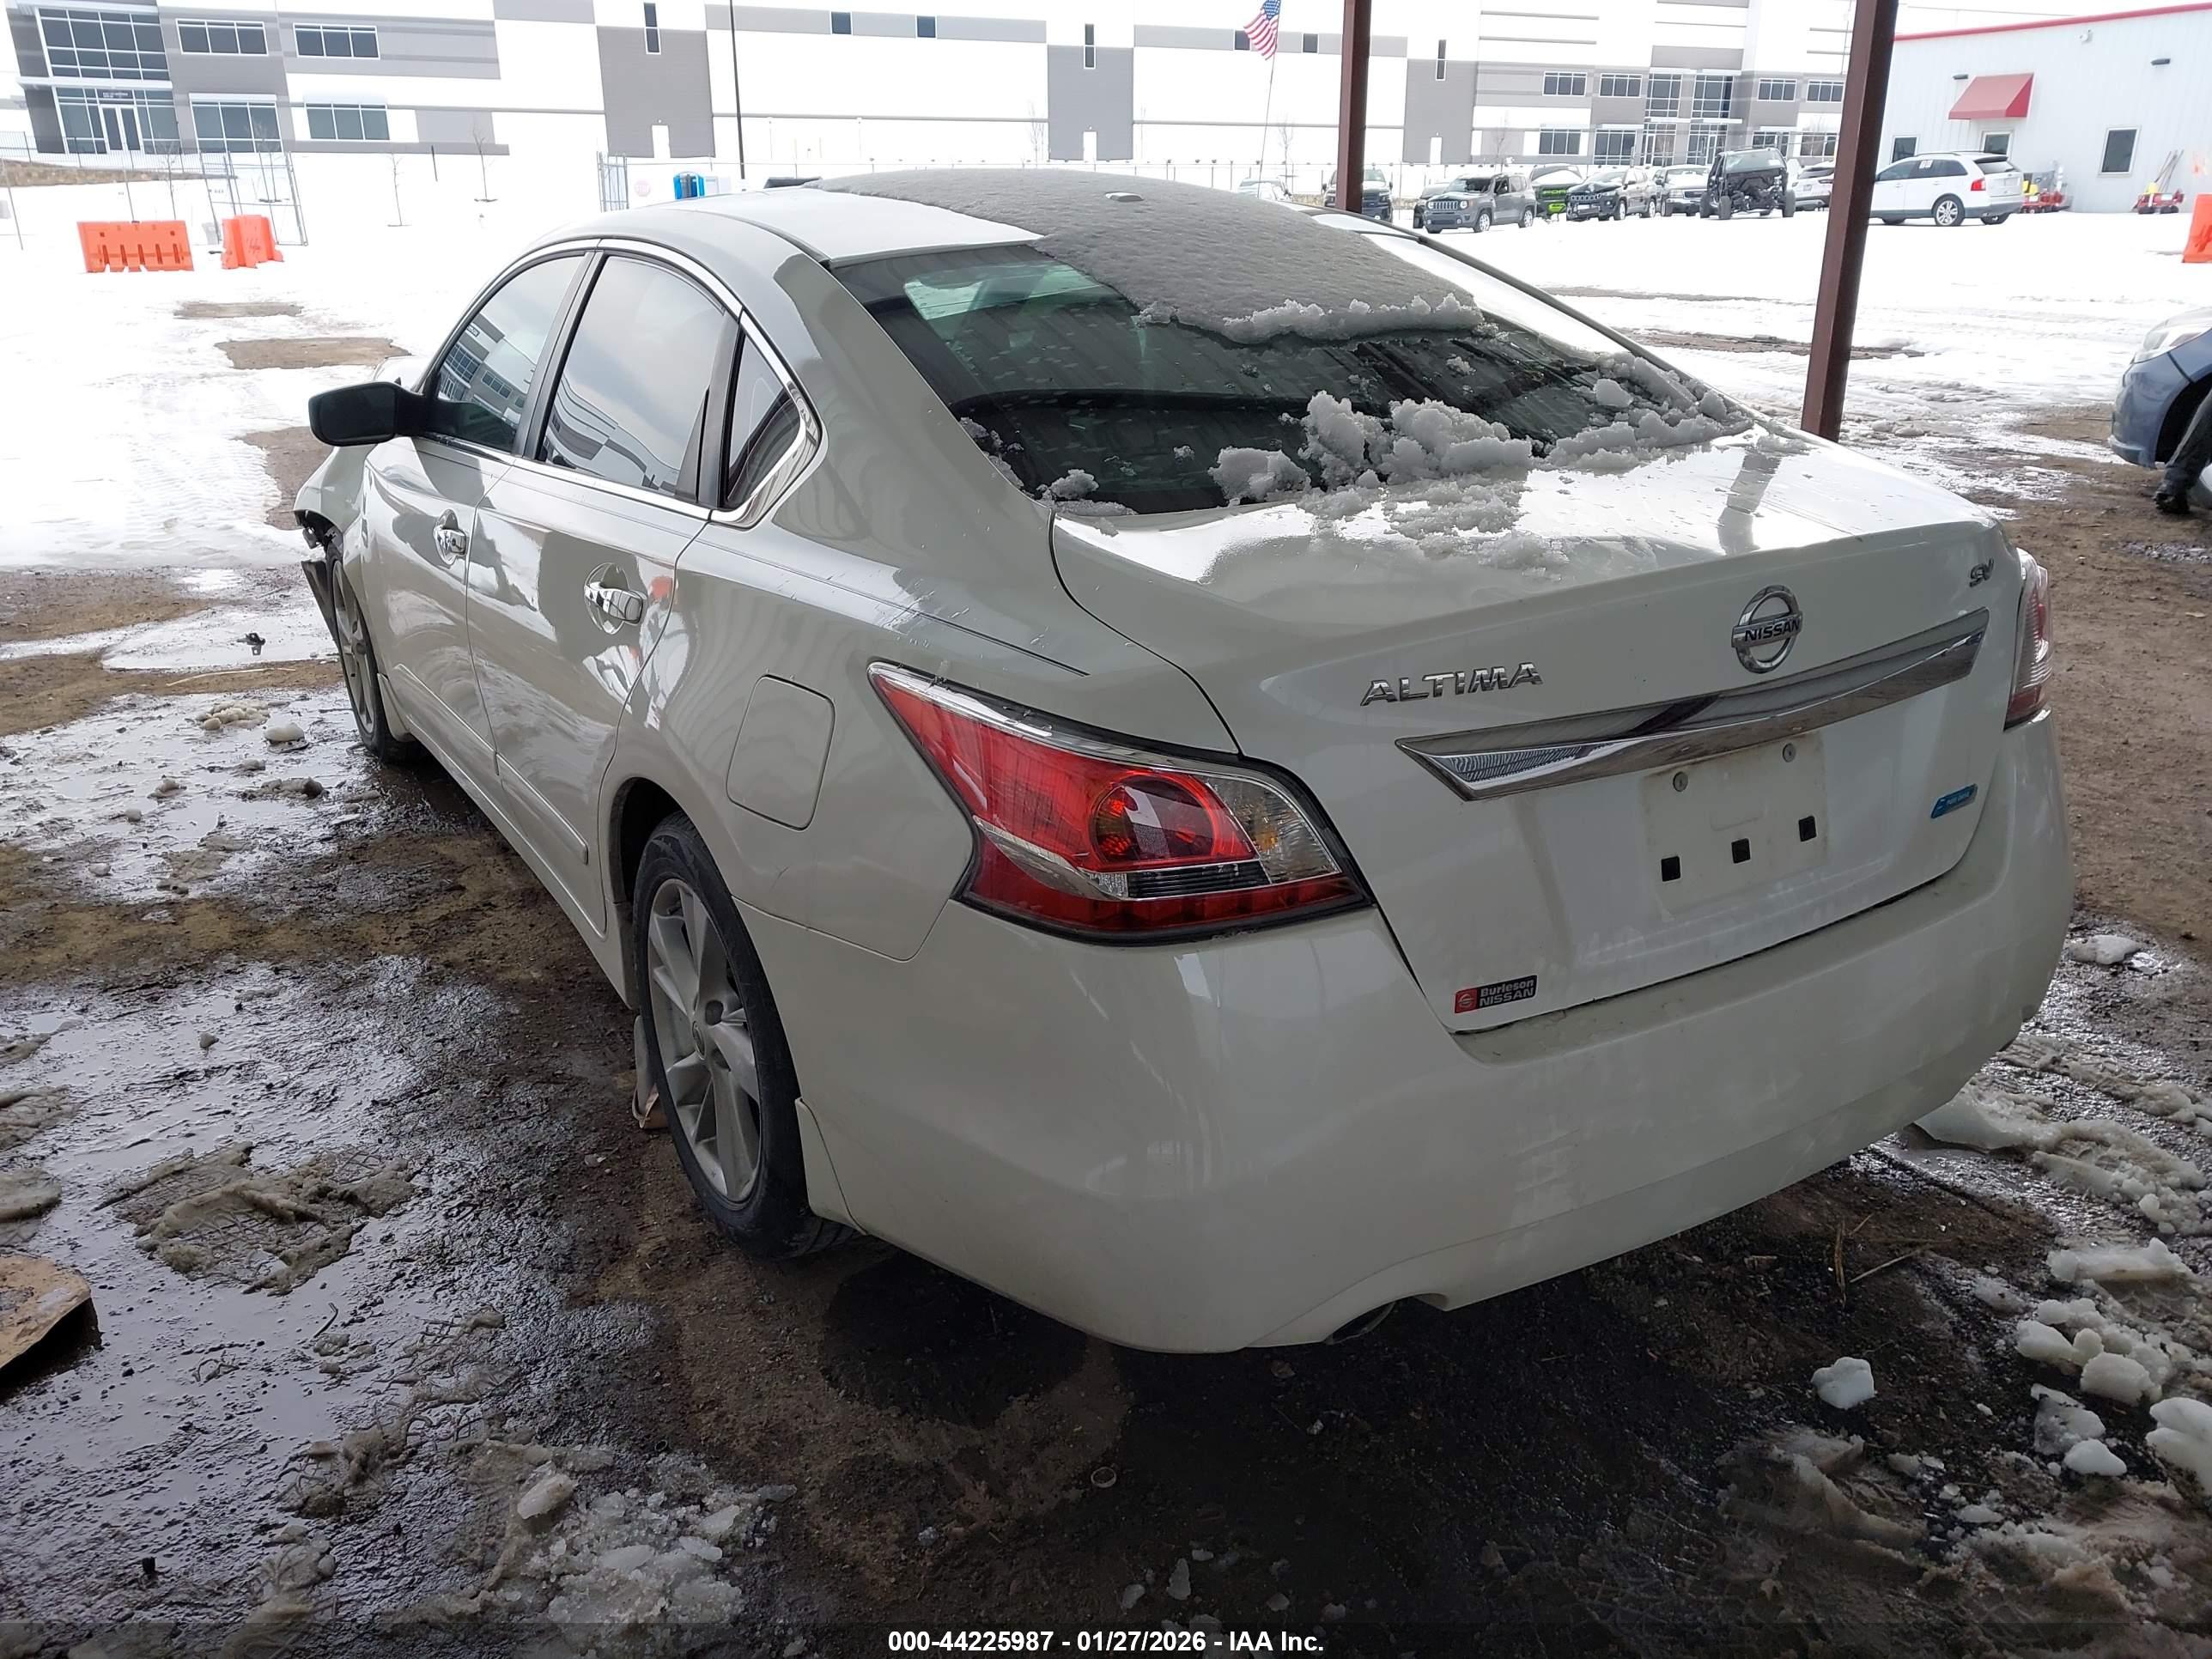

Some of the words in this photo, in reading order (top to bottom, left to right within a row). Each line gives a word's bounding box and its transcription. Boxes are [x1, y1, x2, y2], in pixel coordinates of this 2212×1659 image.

[1969, 558, 1994, 587] SV
[1745, 617, 1801, 641] NISSAN
[1360, 661, 1544, 707] ALTIMA
[1480, 980, 1534, 997] Burleson
[1480, 988, 1534, 1006] NISSAN
